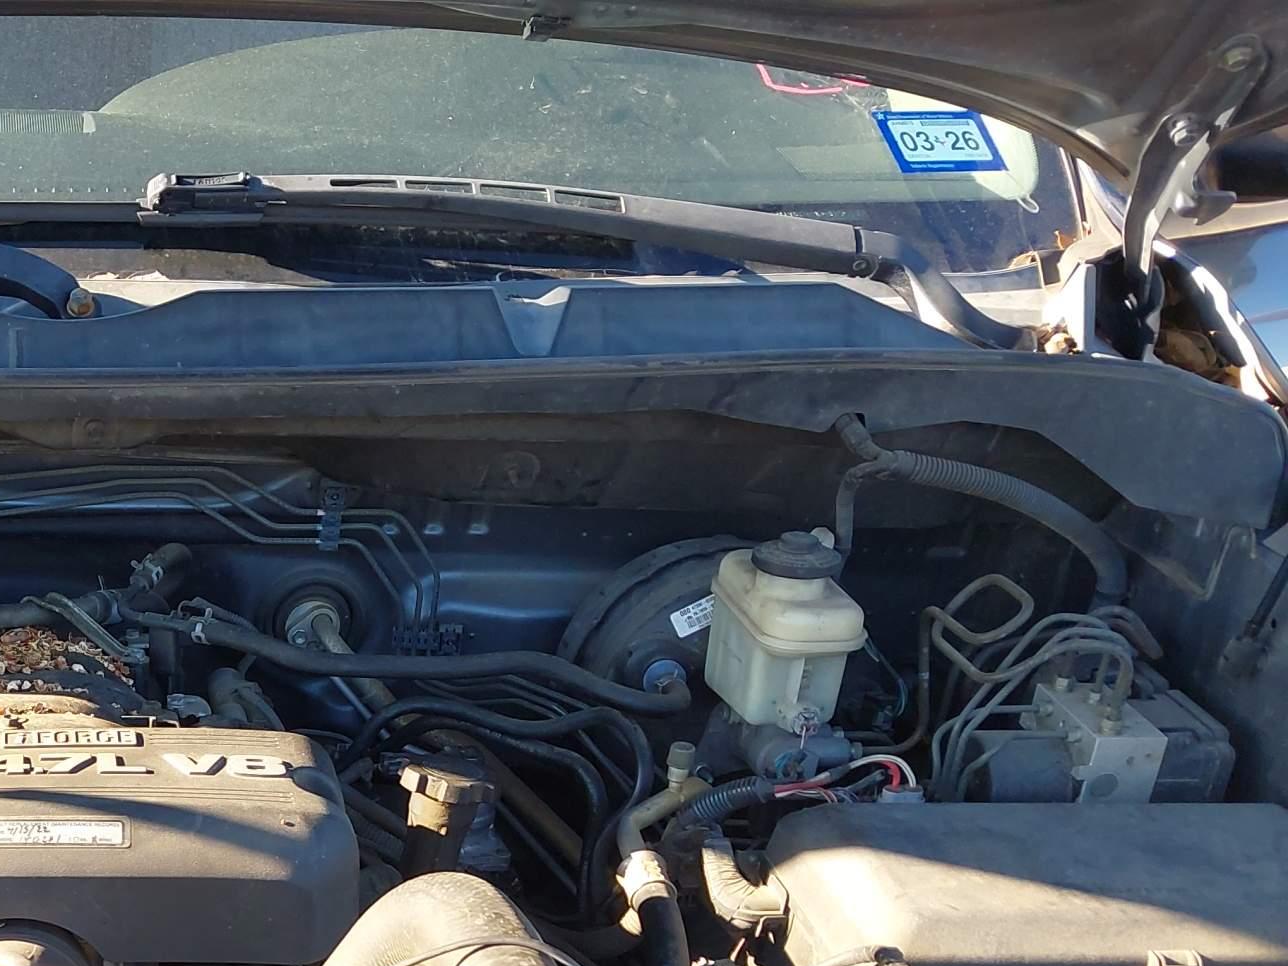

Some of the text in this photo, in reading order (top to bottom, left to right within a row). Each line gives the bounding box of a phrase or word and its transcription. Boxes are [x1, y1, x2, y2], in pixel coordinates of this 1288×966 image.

[899, 130, 980, 152] 03 26
[162, 753, 294, 778] V8
